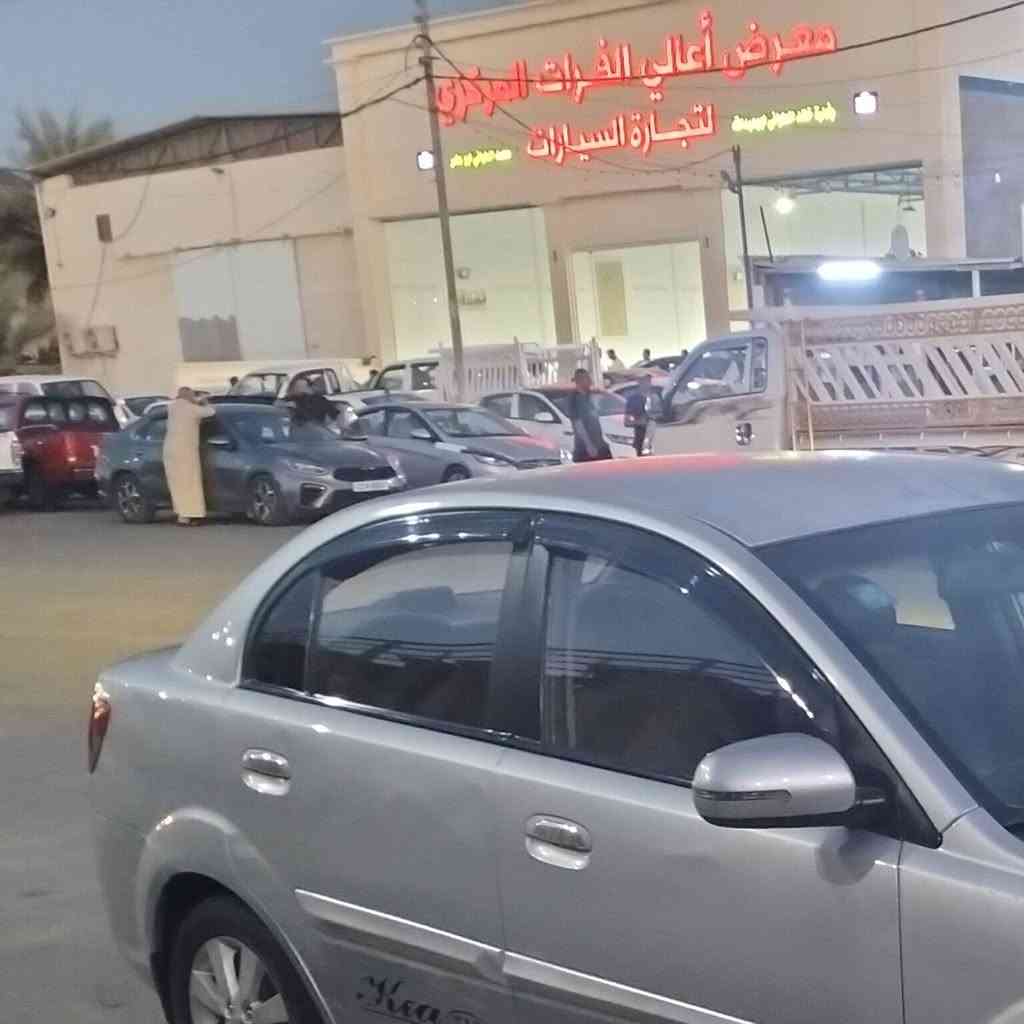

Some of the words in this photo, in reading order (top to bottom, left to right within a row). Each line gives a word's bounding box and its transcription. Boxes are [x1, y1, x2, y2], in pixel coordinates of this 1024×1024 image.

[535, 39, 632, 104] الفرات
[723, 20, 838, 80] معرض
[526, 112, 626, 166] السيارات
[630, 103, 715, 153] لتجارة
